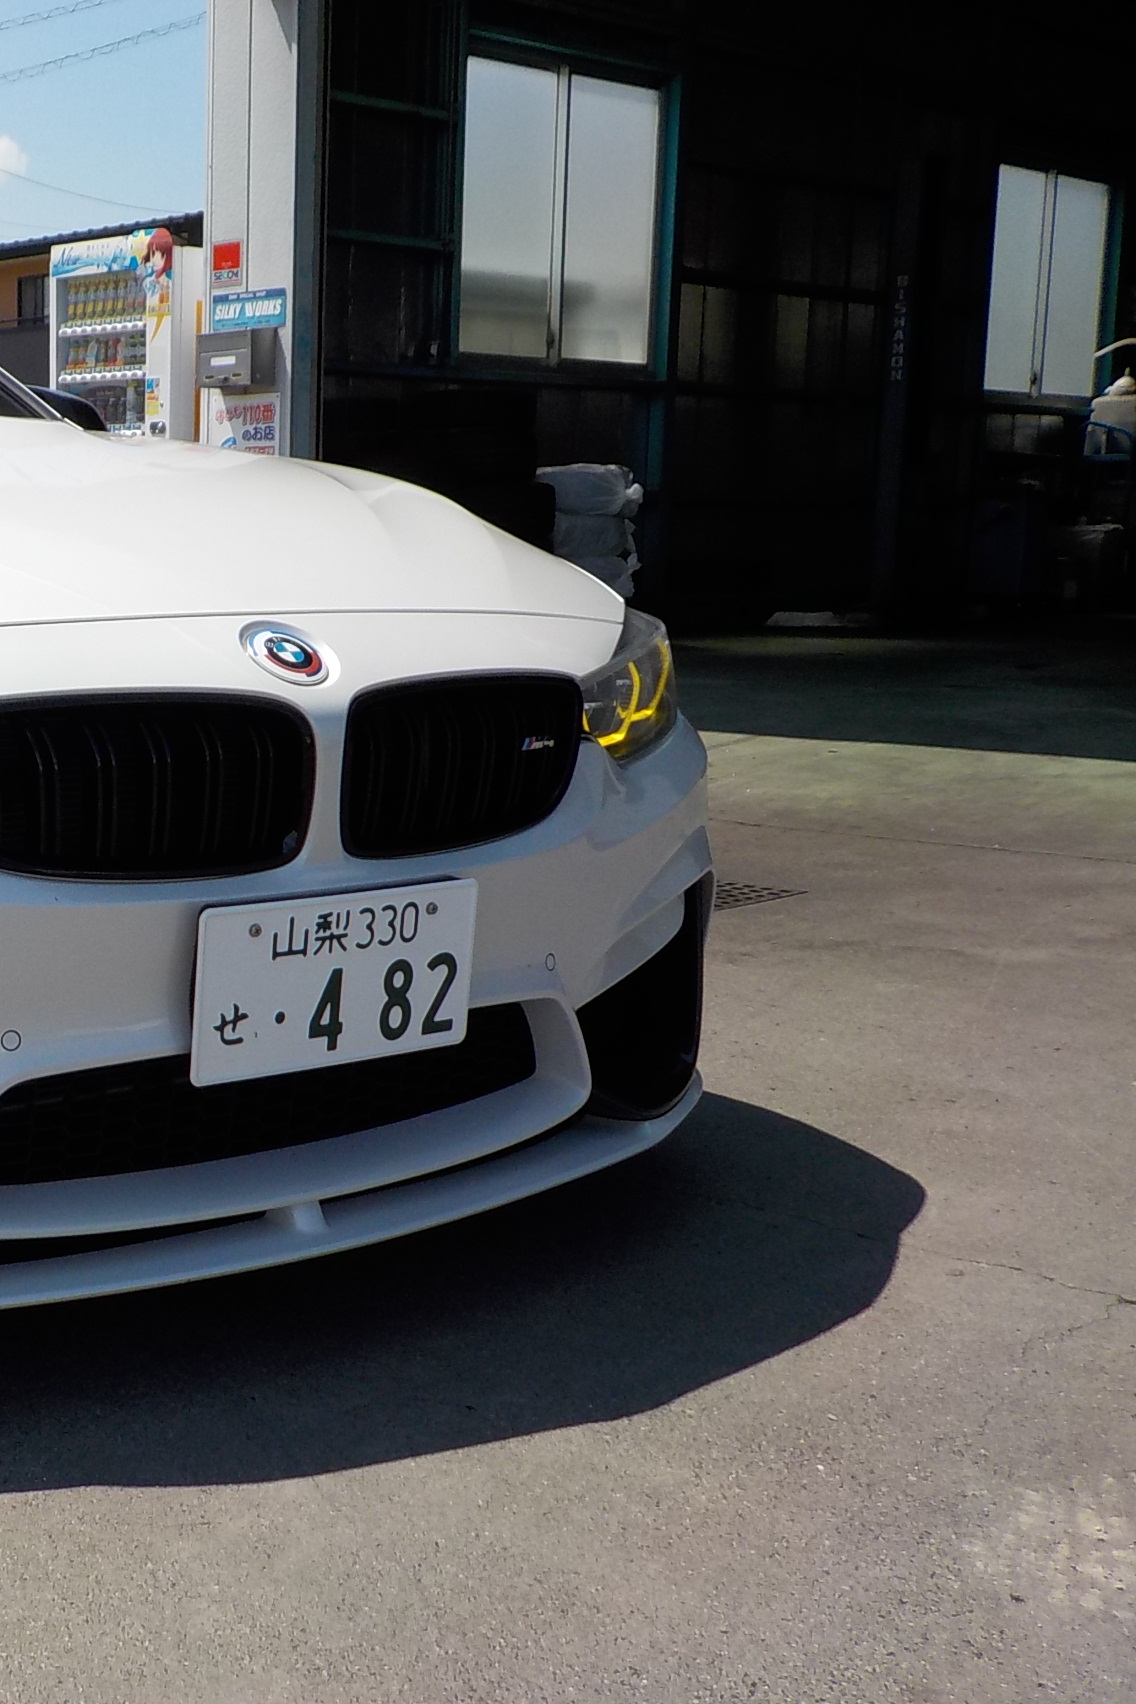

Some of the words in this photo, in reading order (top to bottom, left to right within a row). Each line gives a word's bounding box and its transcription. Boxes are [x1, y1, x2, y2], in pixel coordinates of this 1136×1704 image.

[213, 270, 239, 281] SECOM
[214, 302, 243, 320] SILKY
[244, 298, 282, 317] WORKS
[890, 274, 909, 381] BISHAMON
[242, 425, 275, 441] のお店
